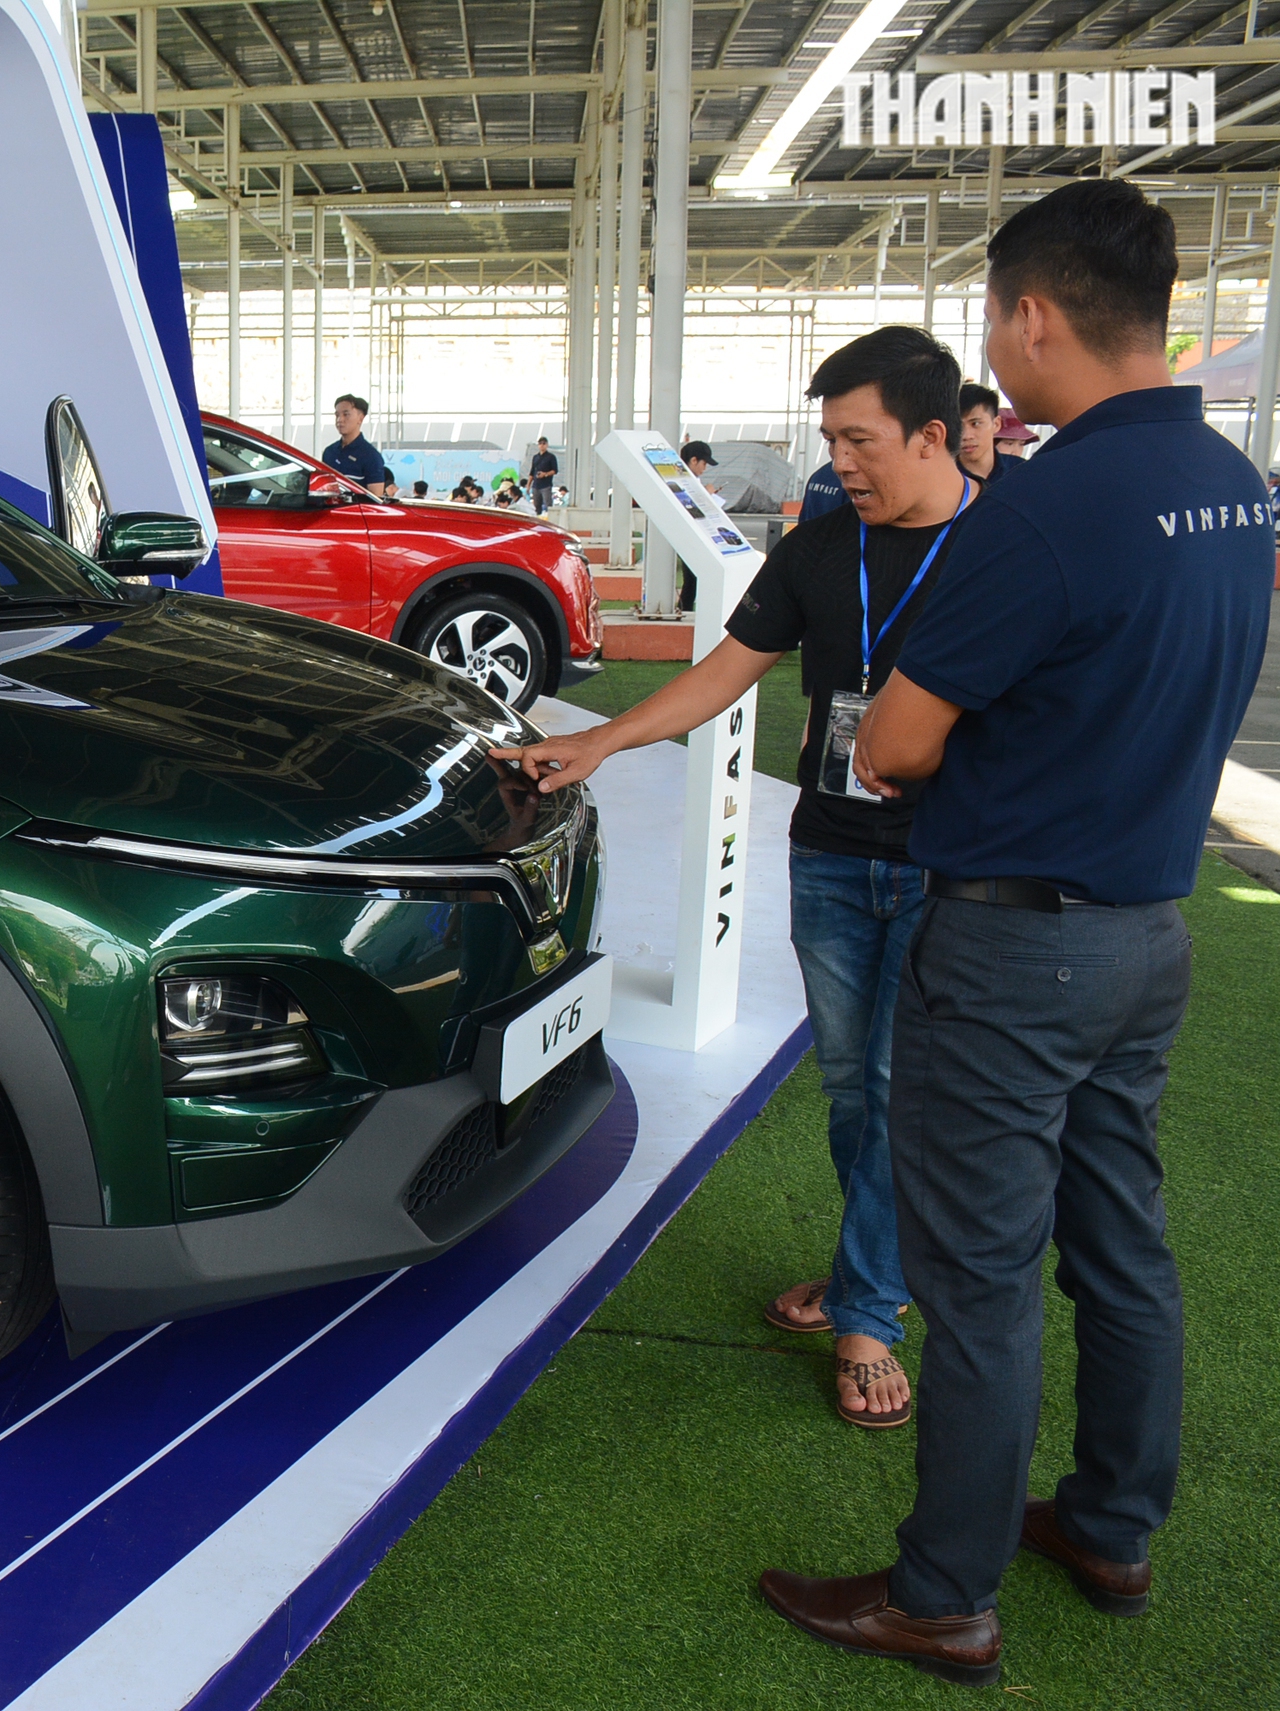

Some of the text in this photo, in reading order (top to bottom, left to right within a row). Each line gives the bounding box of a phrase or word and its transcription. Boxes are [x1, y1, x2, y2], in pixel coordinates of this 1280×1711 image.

[1157, 503, 1273, 537] VINFAST
[715, 706, 744, 948] VINFAS
[542, 995, 583, 1055] VF6
